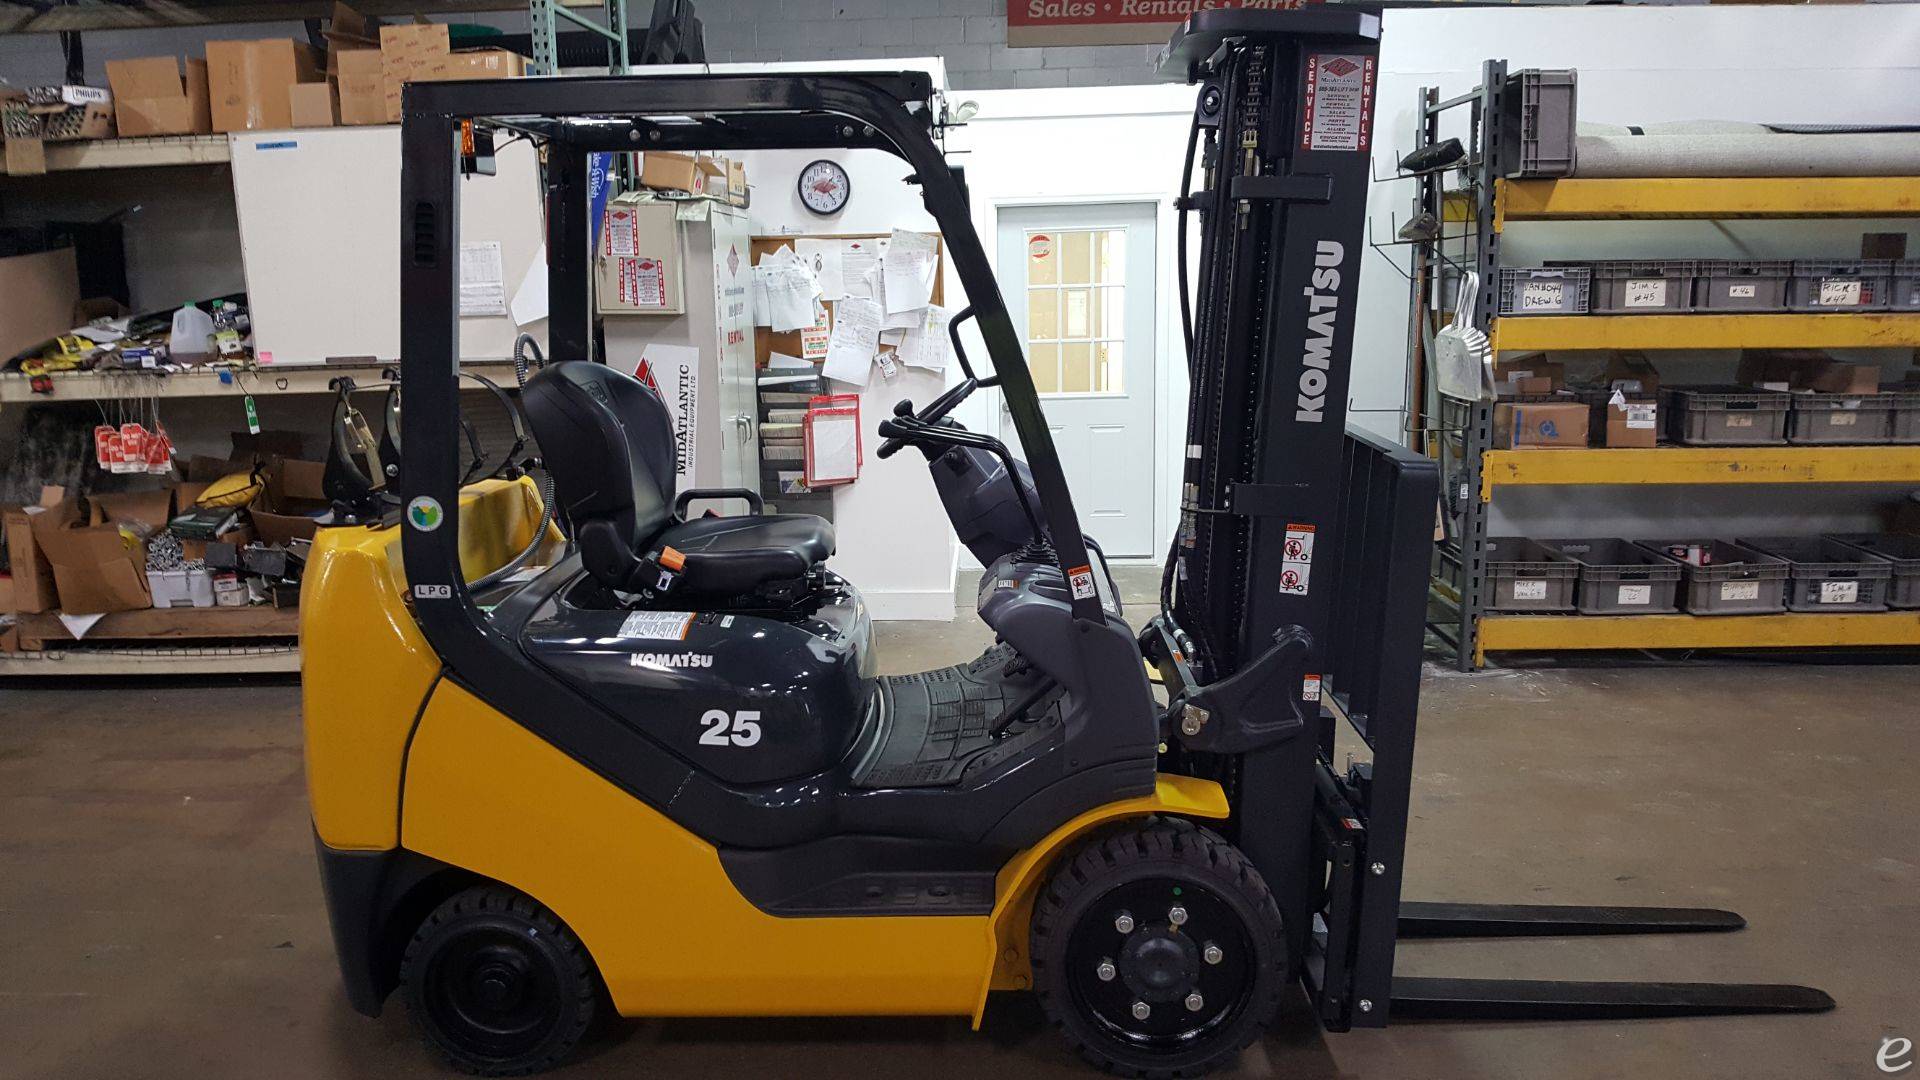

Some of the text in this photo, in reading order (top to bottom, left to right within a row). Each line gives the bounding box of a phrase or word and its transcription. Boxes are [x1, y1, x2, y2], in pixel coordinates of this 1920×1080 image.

[1028, 0, 1096, 18] Sales
[1120, 0, 1216, 16] Rentals
[1303, 58, 1316, 146] SERVICE
[1360, 60, 1373, 147] RENTALS
[1295, 240, 1344, 423] KOMATSU
[630, 651, 714, 668] KOMATSU
[698, 709, 762, 748] 25
